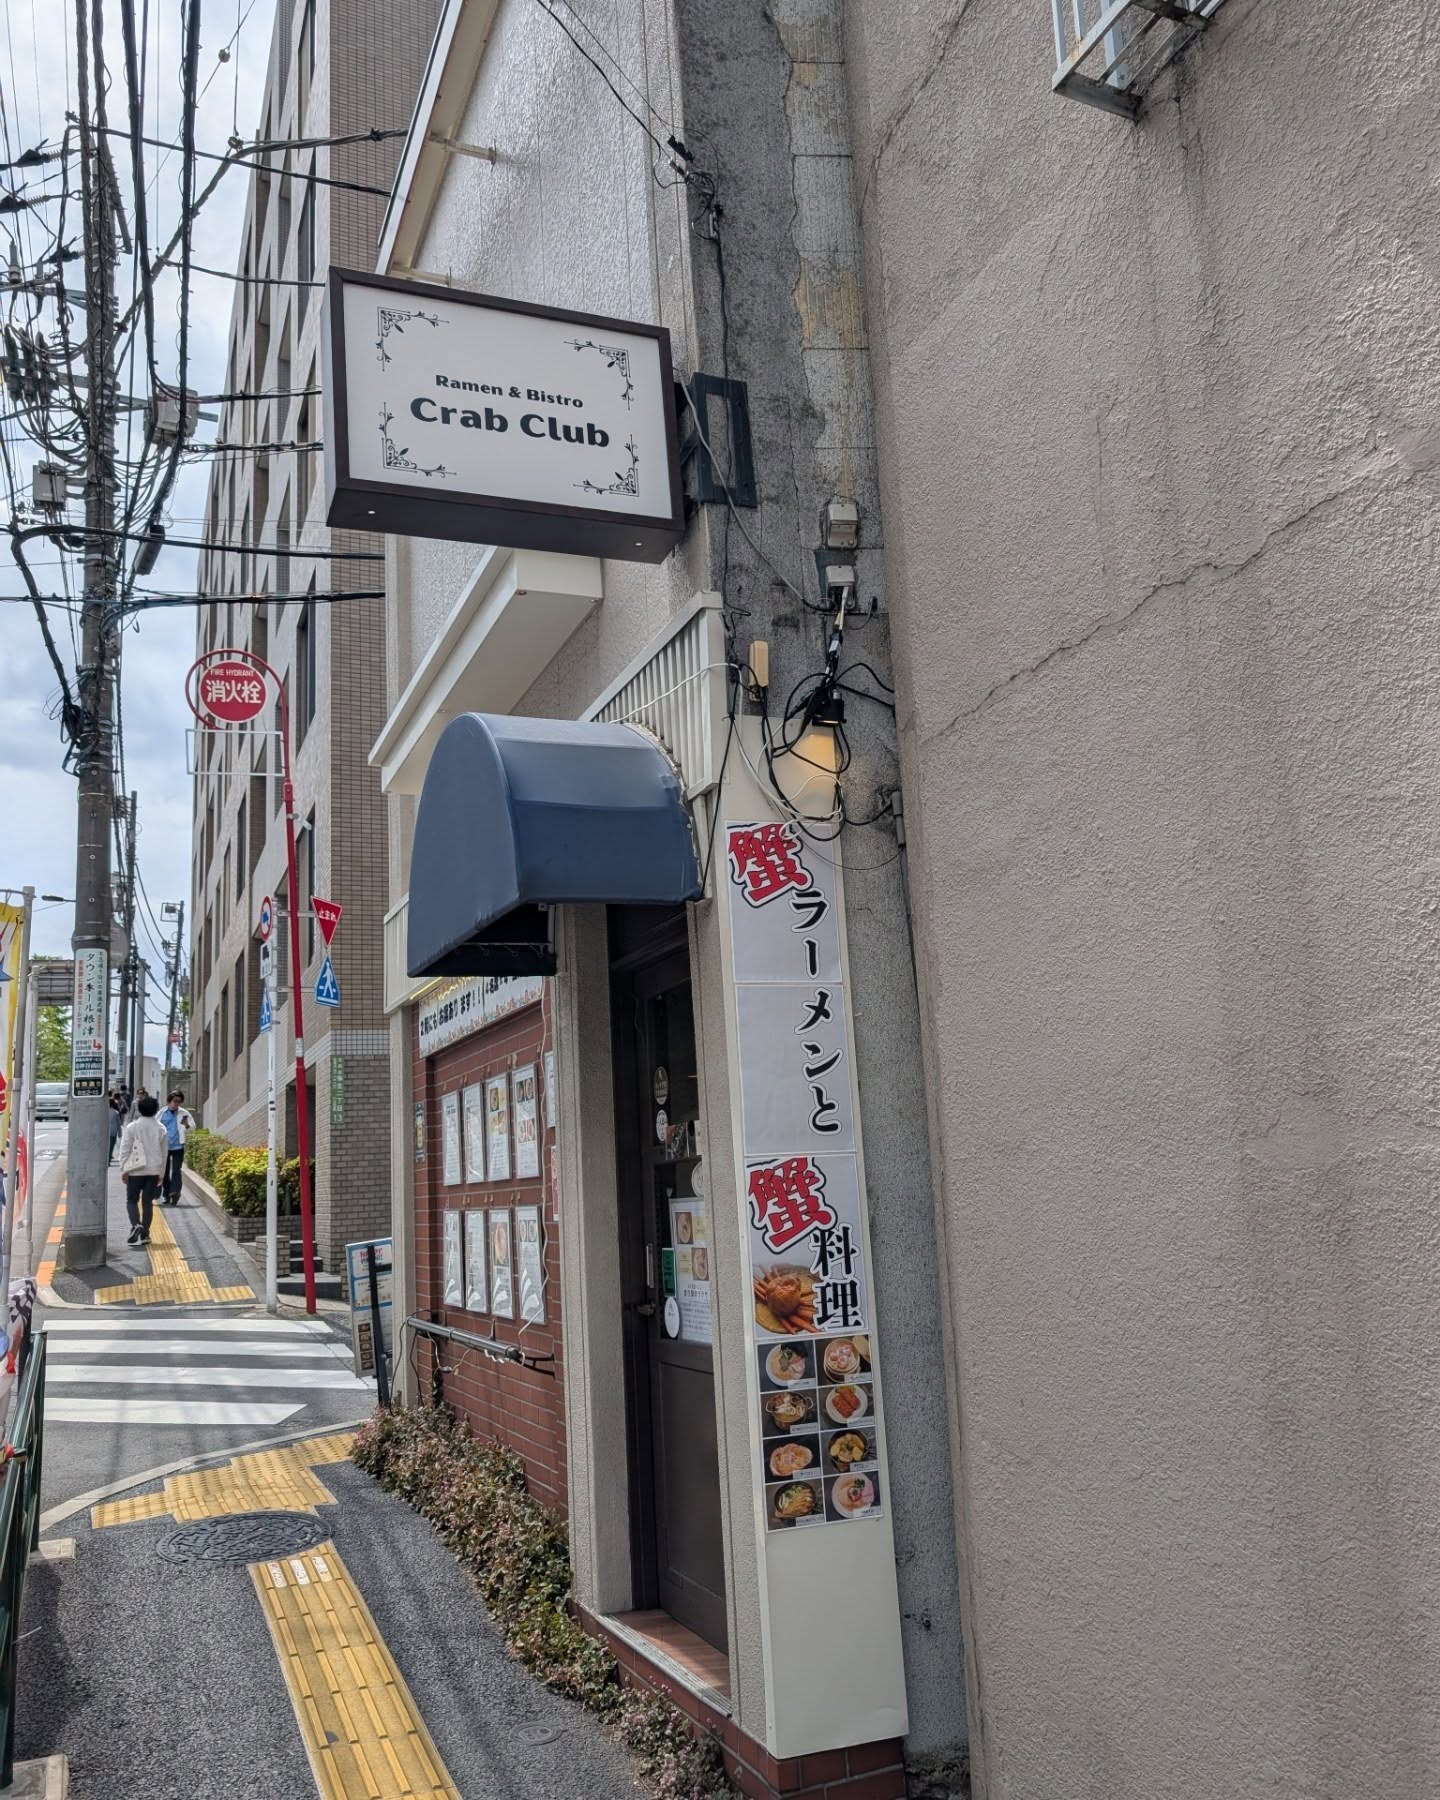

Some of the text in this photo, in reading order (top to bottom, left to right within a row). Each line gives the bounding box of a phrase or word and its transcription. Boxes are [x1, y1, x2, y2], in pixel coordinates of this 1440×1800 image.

[435, 374, 583, 408] Ramen & Bistro
[410, 397, 609, 448] Crab Club
[226, 668, 254, 677] HYDRANT
[206, 680, 262, 704] 消火栓
[319, 909, 337, 922] 止まれ
[82, 952, 96, 1037] タウンホール根津
[749, 1157, 861, 1327] 蟹料理
